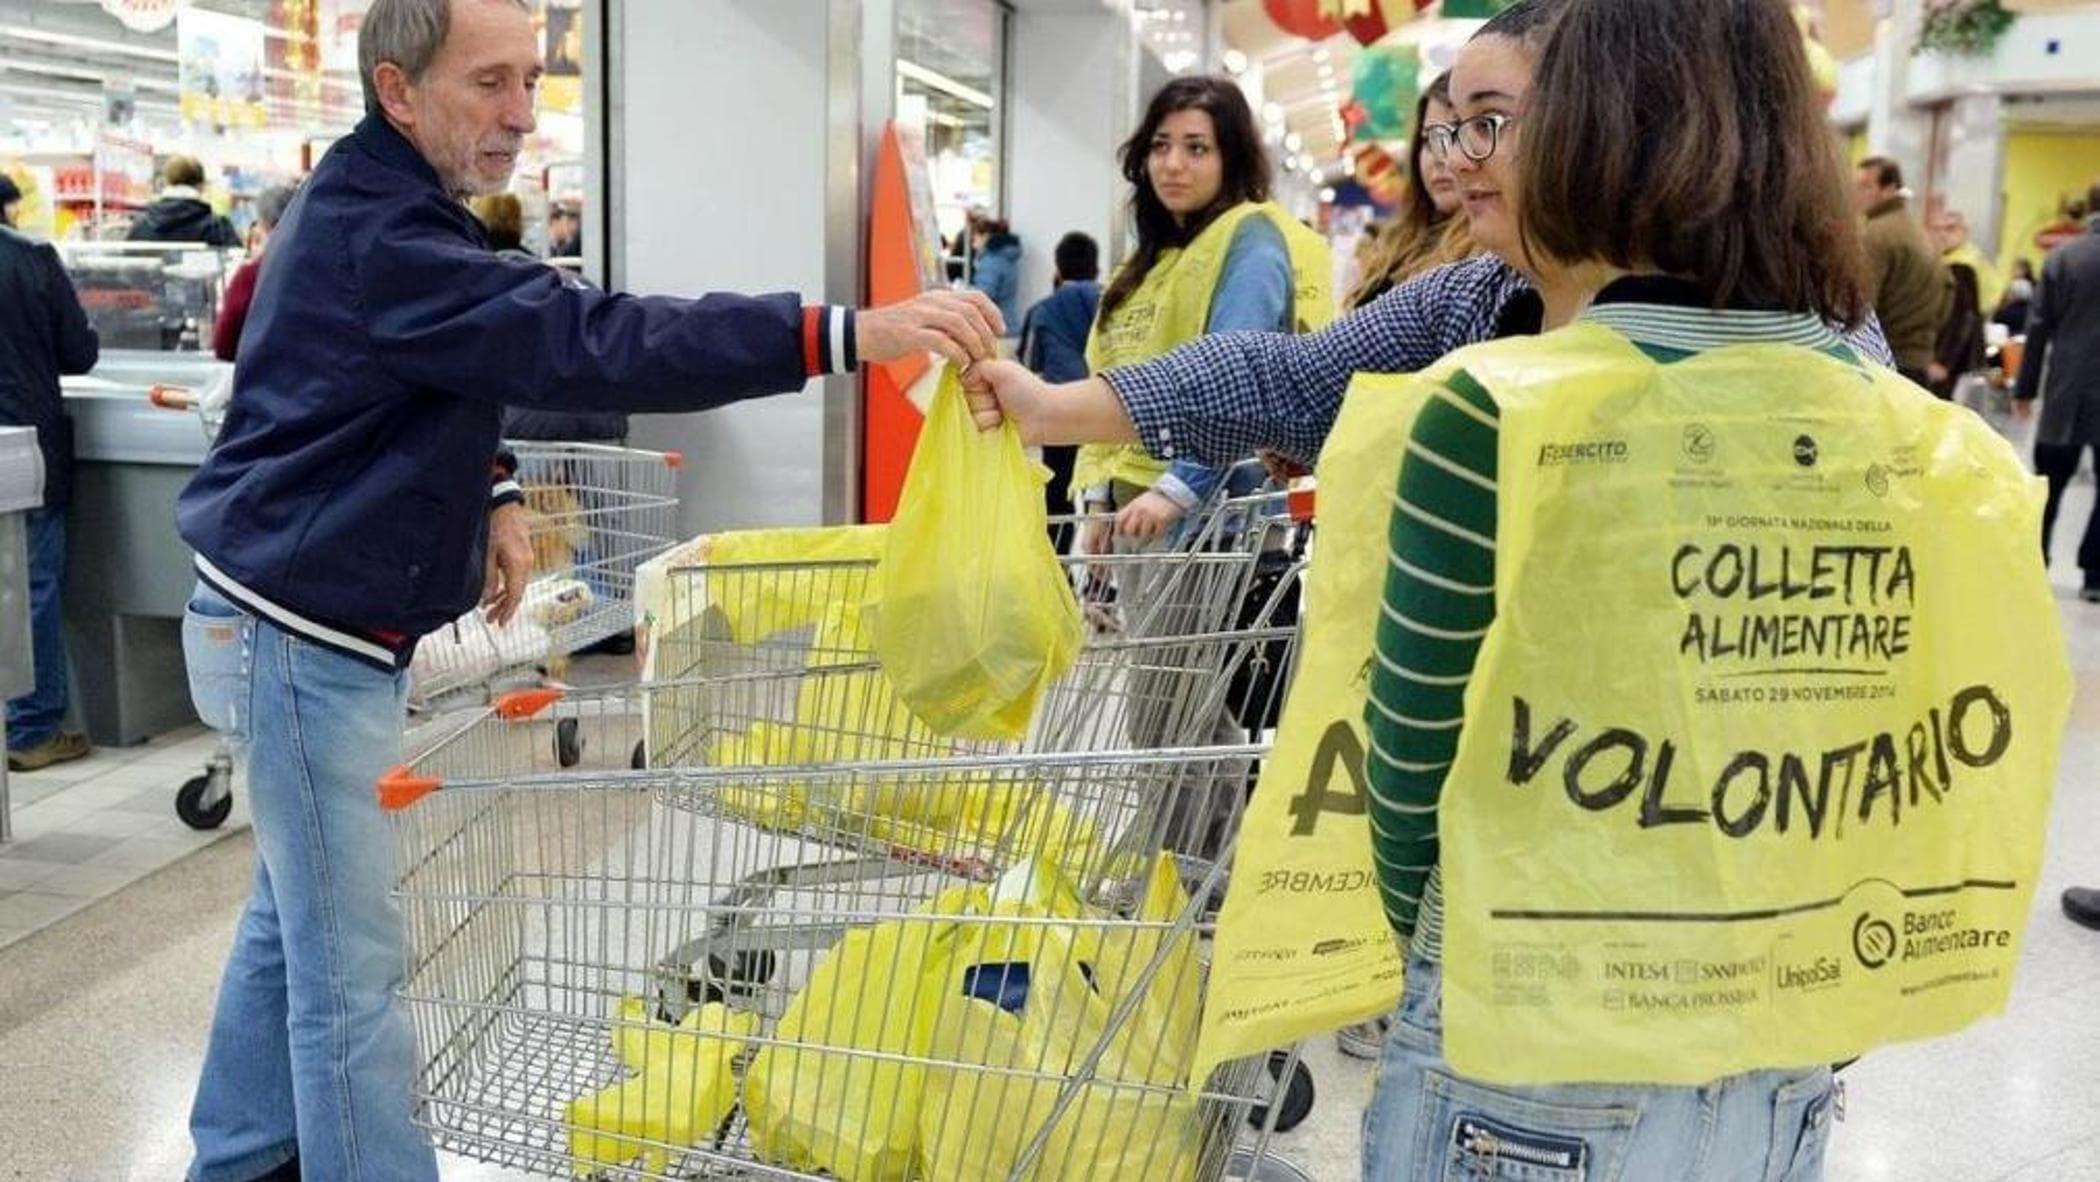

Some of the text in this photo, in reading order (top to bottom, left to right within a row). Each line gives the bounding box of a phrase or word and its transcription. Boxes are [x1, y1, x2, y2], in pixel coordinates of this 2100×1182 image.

[1855, 519, 1893, 533] DELLA
[1671, 543, 1915, 608] COLLETTA
[1679, 613, 1912, 662] ALIMENTARE
[1694, 688, 1765, 702] SABATO
[1769, 687, 1790, 701] 29
[1793, 685, 1867, 701] NOVEMBRE
[1509, 683, 2012, 840] VOLONTARIO
